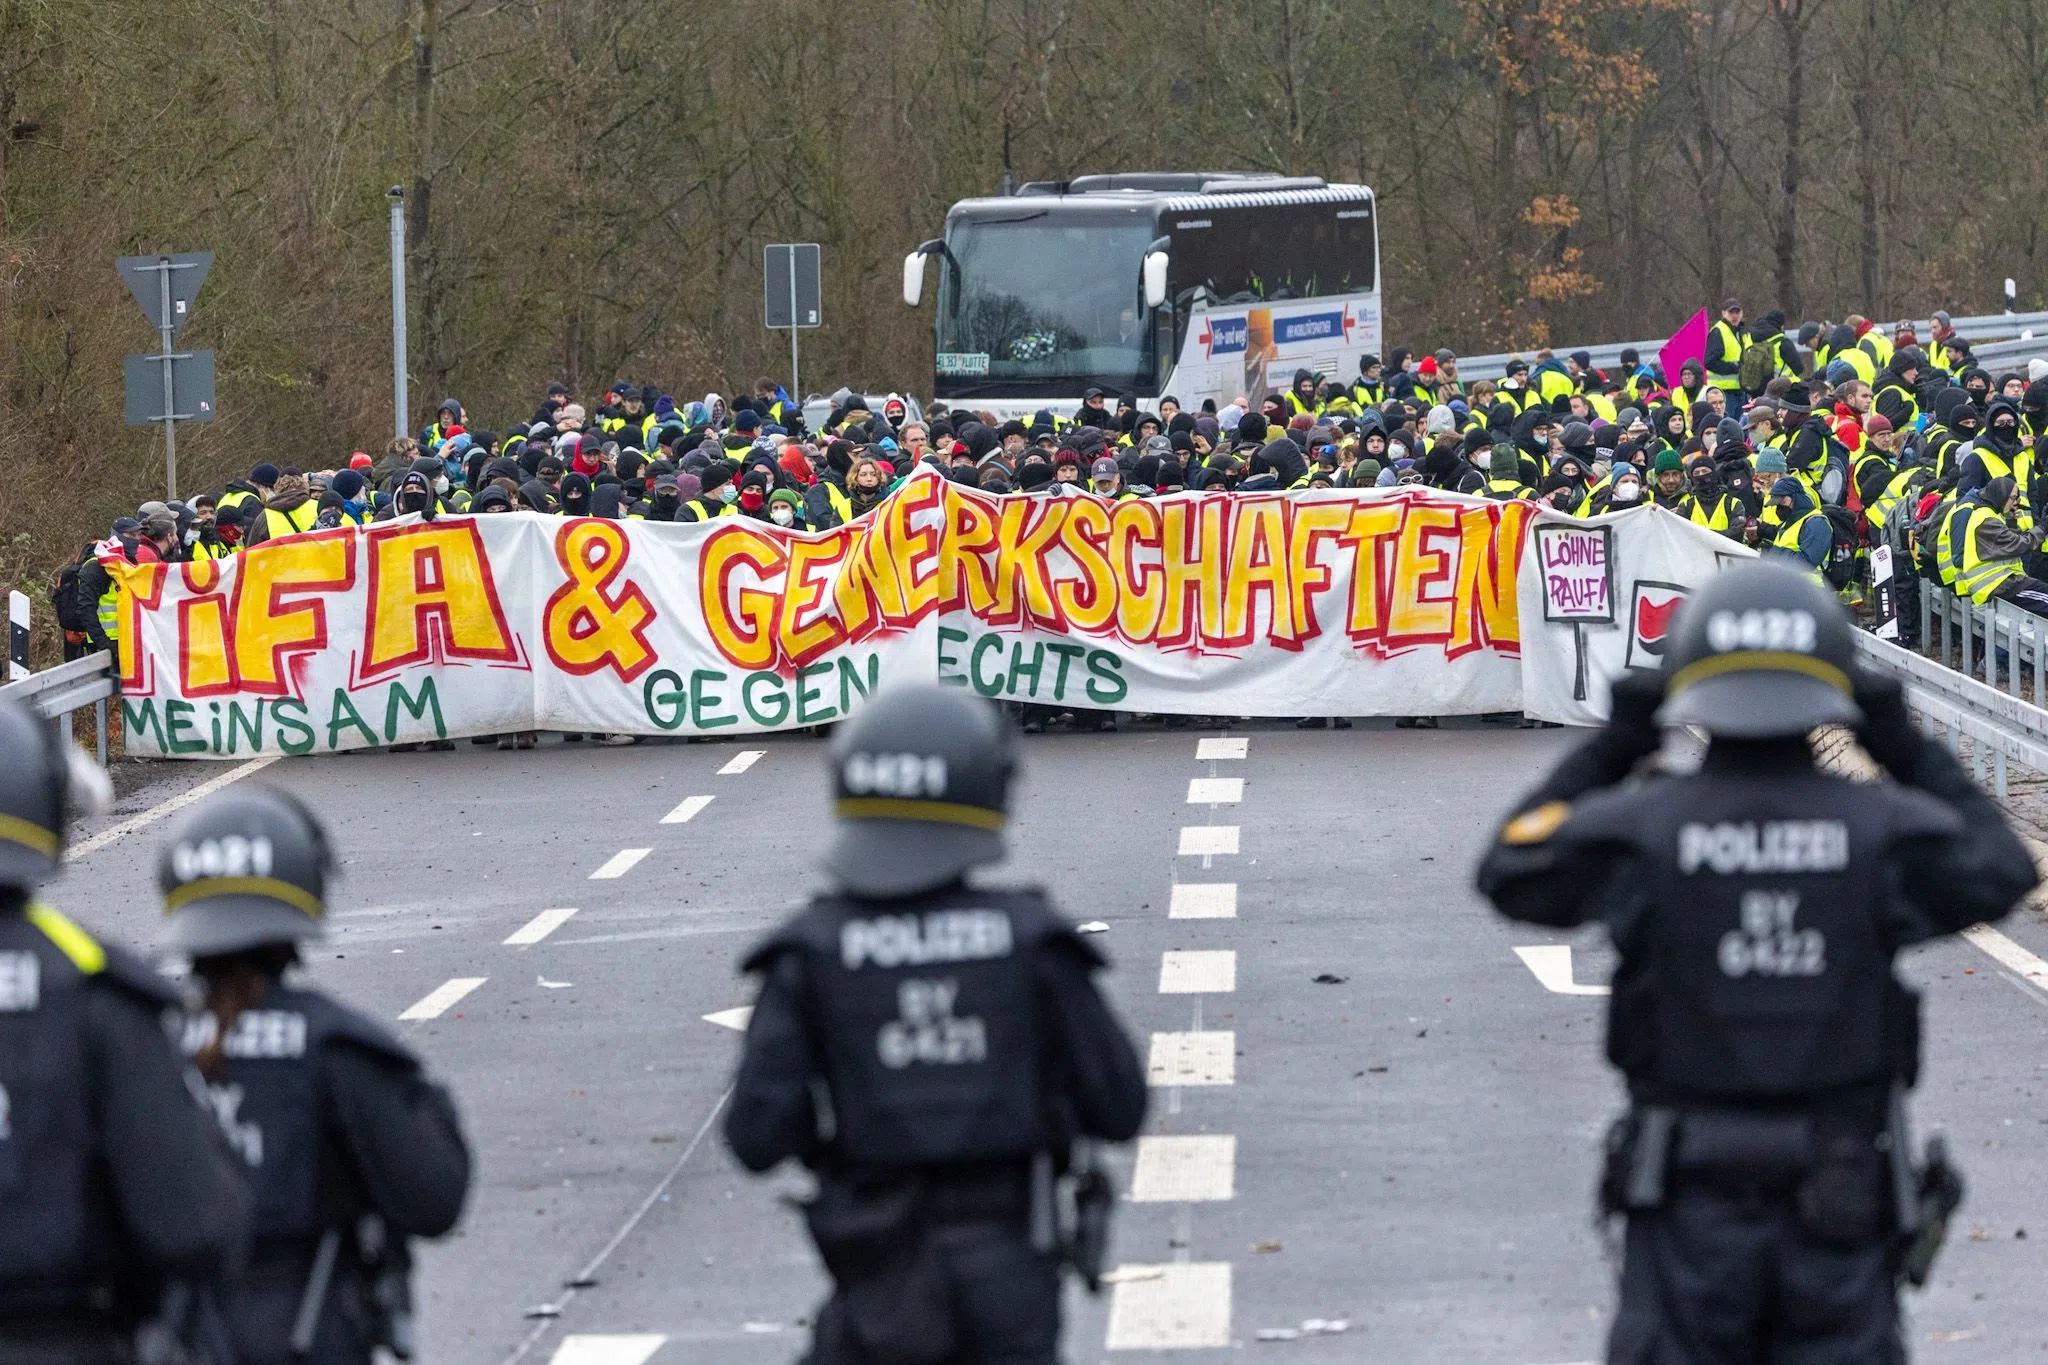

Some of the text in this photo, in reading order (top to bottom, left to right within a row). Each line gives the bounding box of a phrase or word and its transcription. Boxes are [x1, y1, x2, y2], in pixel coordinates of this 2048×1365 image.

[543, 516, 658, 684] &
[700, 473, 1540, 672] GEWERKSCHAFTEN
[1544, 532, 1606, 569] LÖHNE
[1548, 574, 1608, 613] RAUF!
[644, 653, 879, 730] GEGEN
[1678, 819, 1850, 876] POLIZEI
[840, 909, 1013, 969] POLIZEI
